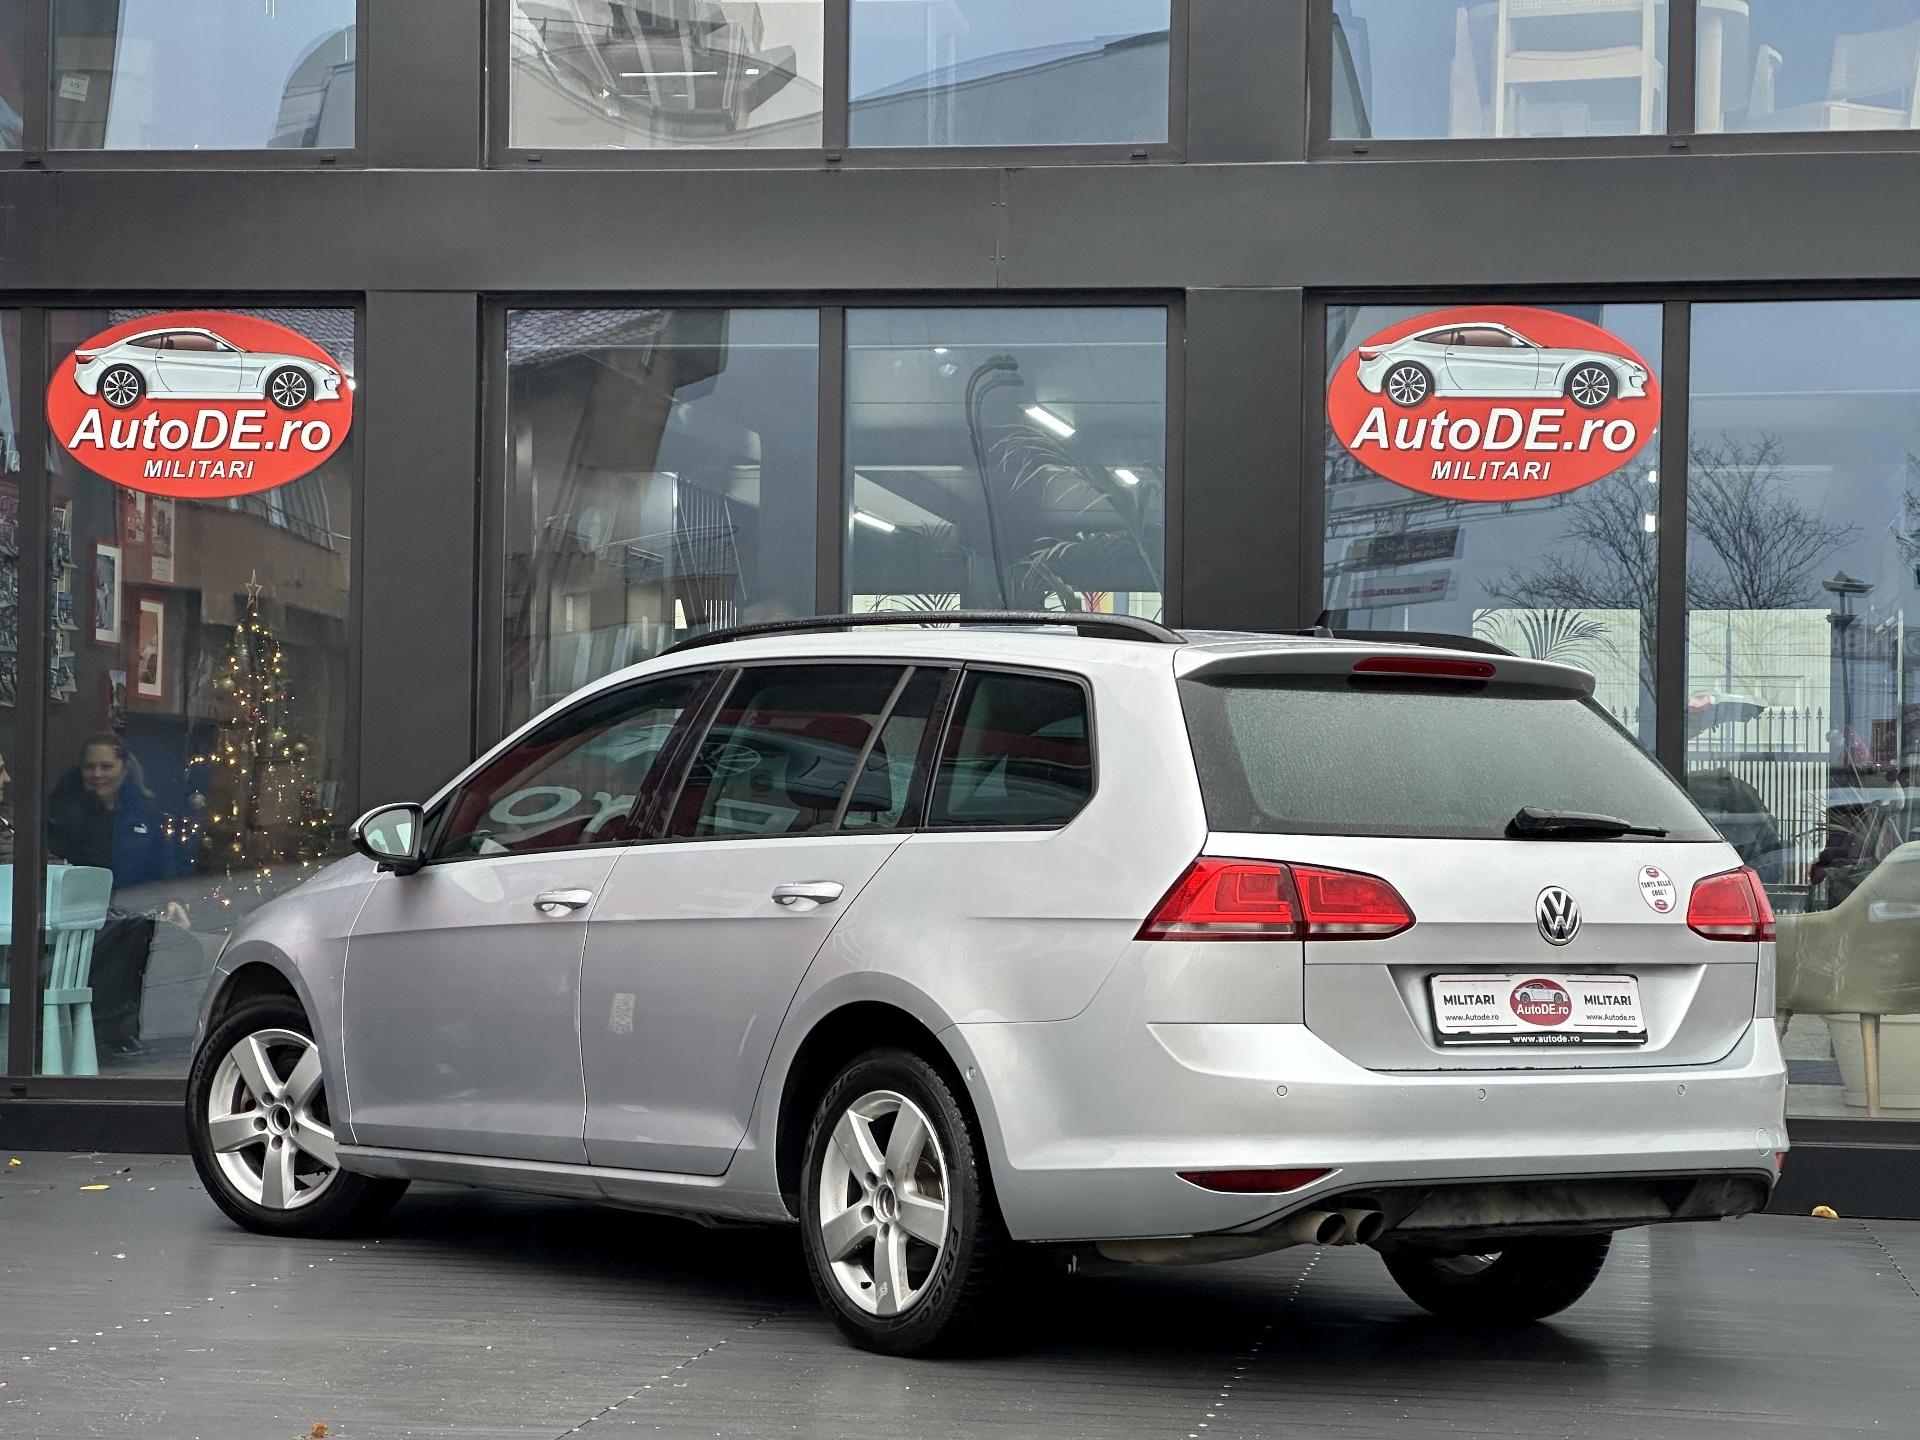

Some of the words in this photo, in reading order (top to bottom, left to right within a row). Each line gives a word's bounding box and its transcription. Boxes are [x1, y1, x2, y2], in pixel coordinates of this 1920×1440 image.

[67, 408, 332, 452] AutoDE.ro
[1350, 406, 1636, 452] AutoDE.ro
[143, 459, 254, 479] MILITARI
[1431, 460, 1551, 481] MILITARI
[1443, 994, 1495, 1006] MILITARI
[1516, 1003, 1569, 1015] AutoDE.ro
[1583, 994, 1632, 1006] MILITARI
[1512, 1034, 1580, 1043] www.autode.ro
[918, 1225, 961, 1325] FRIGO
